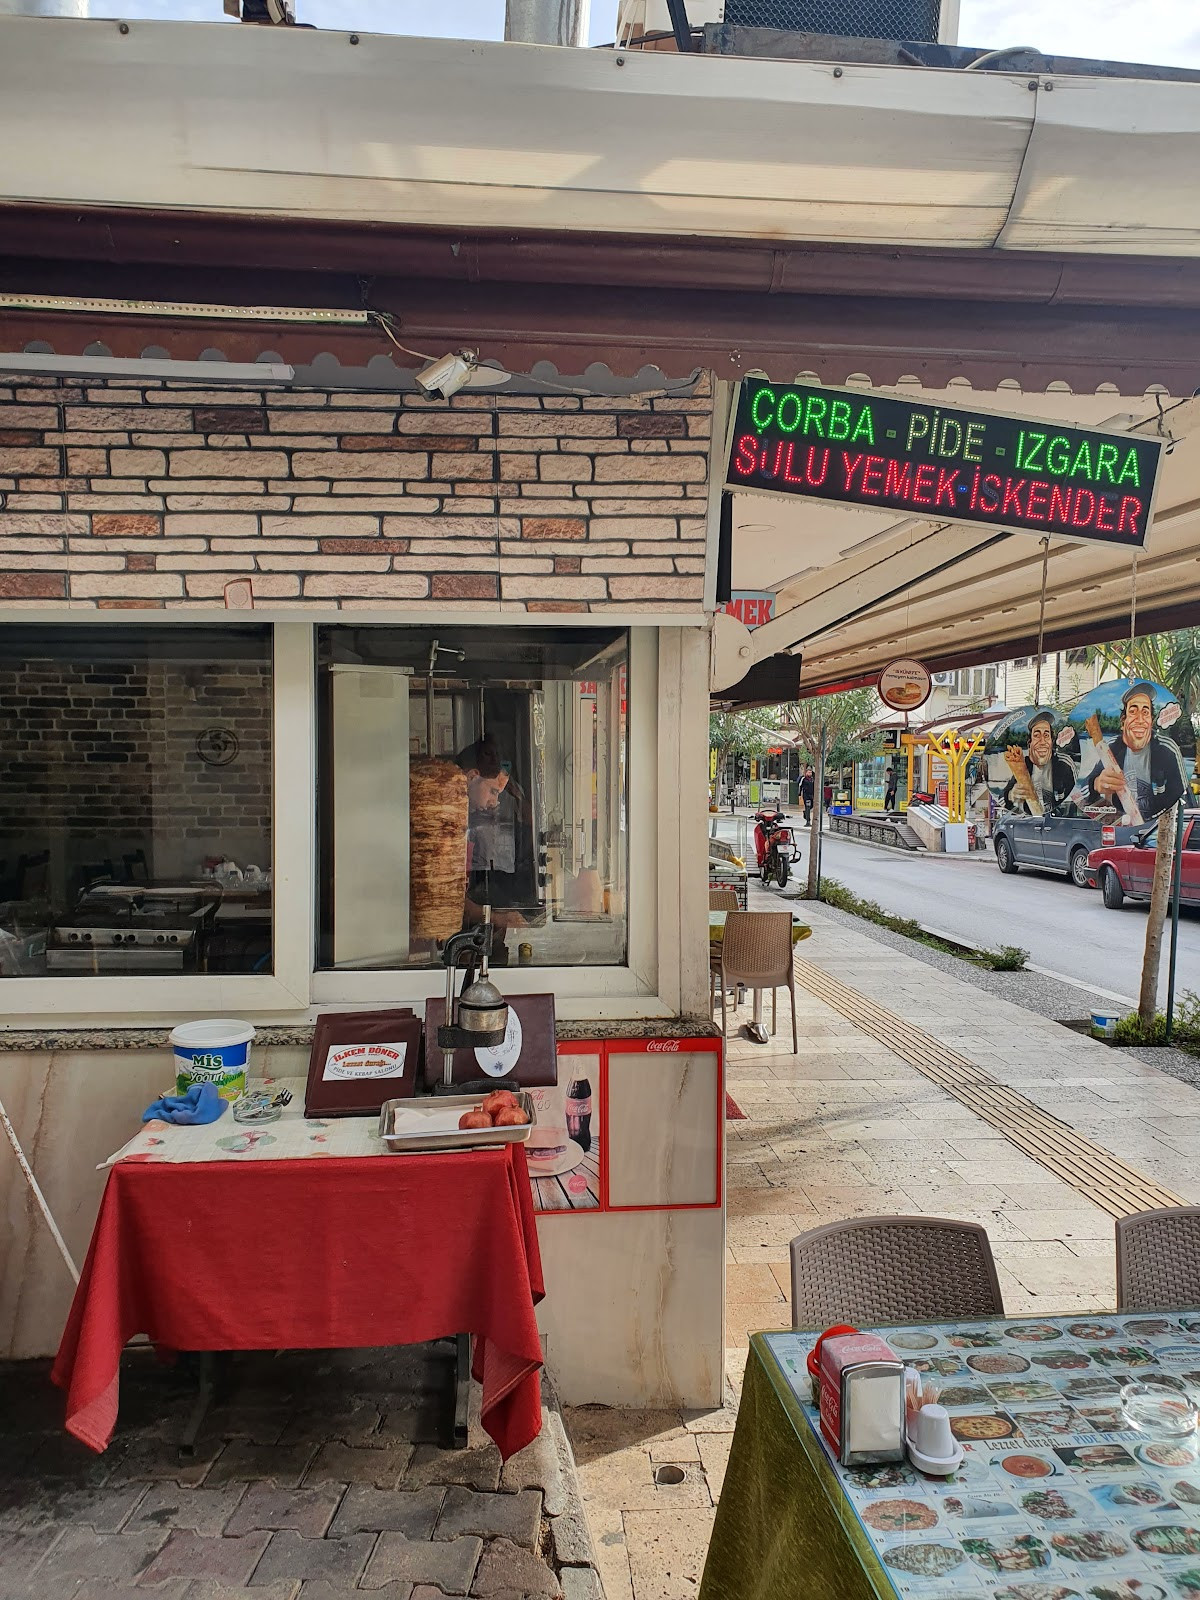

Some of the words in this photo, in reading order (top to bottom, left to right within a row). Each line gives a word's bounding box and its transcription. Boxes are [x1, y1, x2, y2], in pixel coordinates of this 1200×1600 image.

[751, 387, 875, 446] ÇORBA
[905, 409, 986, 462] PİDE
[1014, 430, 1141, 488] IZGARA
[734, 435, 830, 487] SULU
[714, 599, 773, 625] MEK
[368, 1046, 400, 1060] DÖNER
[983, 1440, 1023, 1451] Lezzet
[1100, 1433, 1118, 1443] VE
